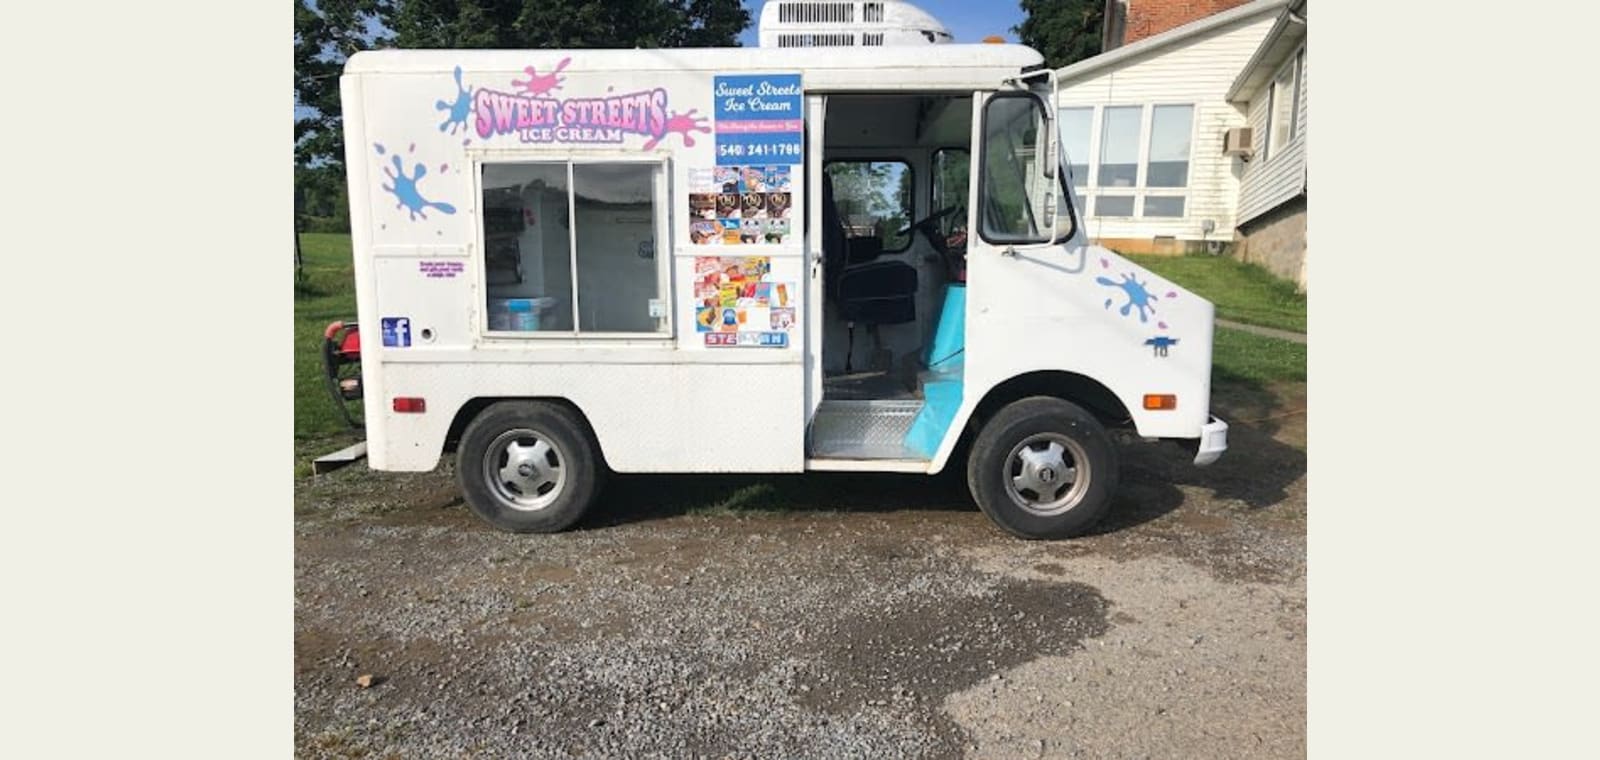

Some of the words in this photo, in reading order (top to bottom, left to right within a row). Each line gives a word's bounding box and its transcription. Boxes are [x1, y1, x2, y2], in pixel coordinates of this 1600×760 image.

[715, 82, 754, 97] Sweet
[756, 80, 801, 96] Streets
[724, 97, 746, 112] Ice
[747, 96, 792, 112] Cream
[475, 88, 558, 137] SWEET
[562, 88, 667, 138] STREETS
[521, 128, 551, 142] ICE
[556, 128, 623, 142] CREAM
